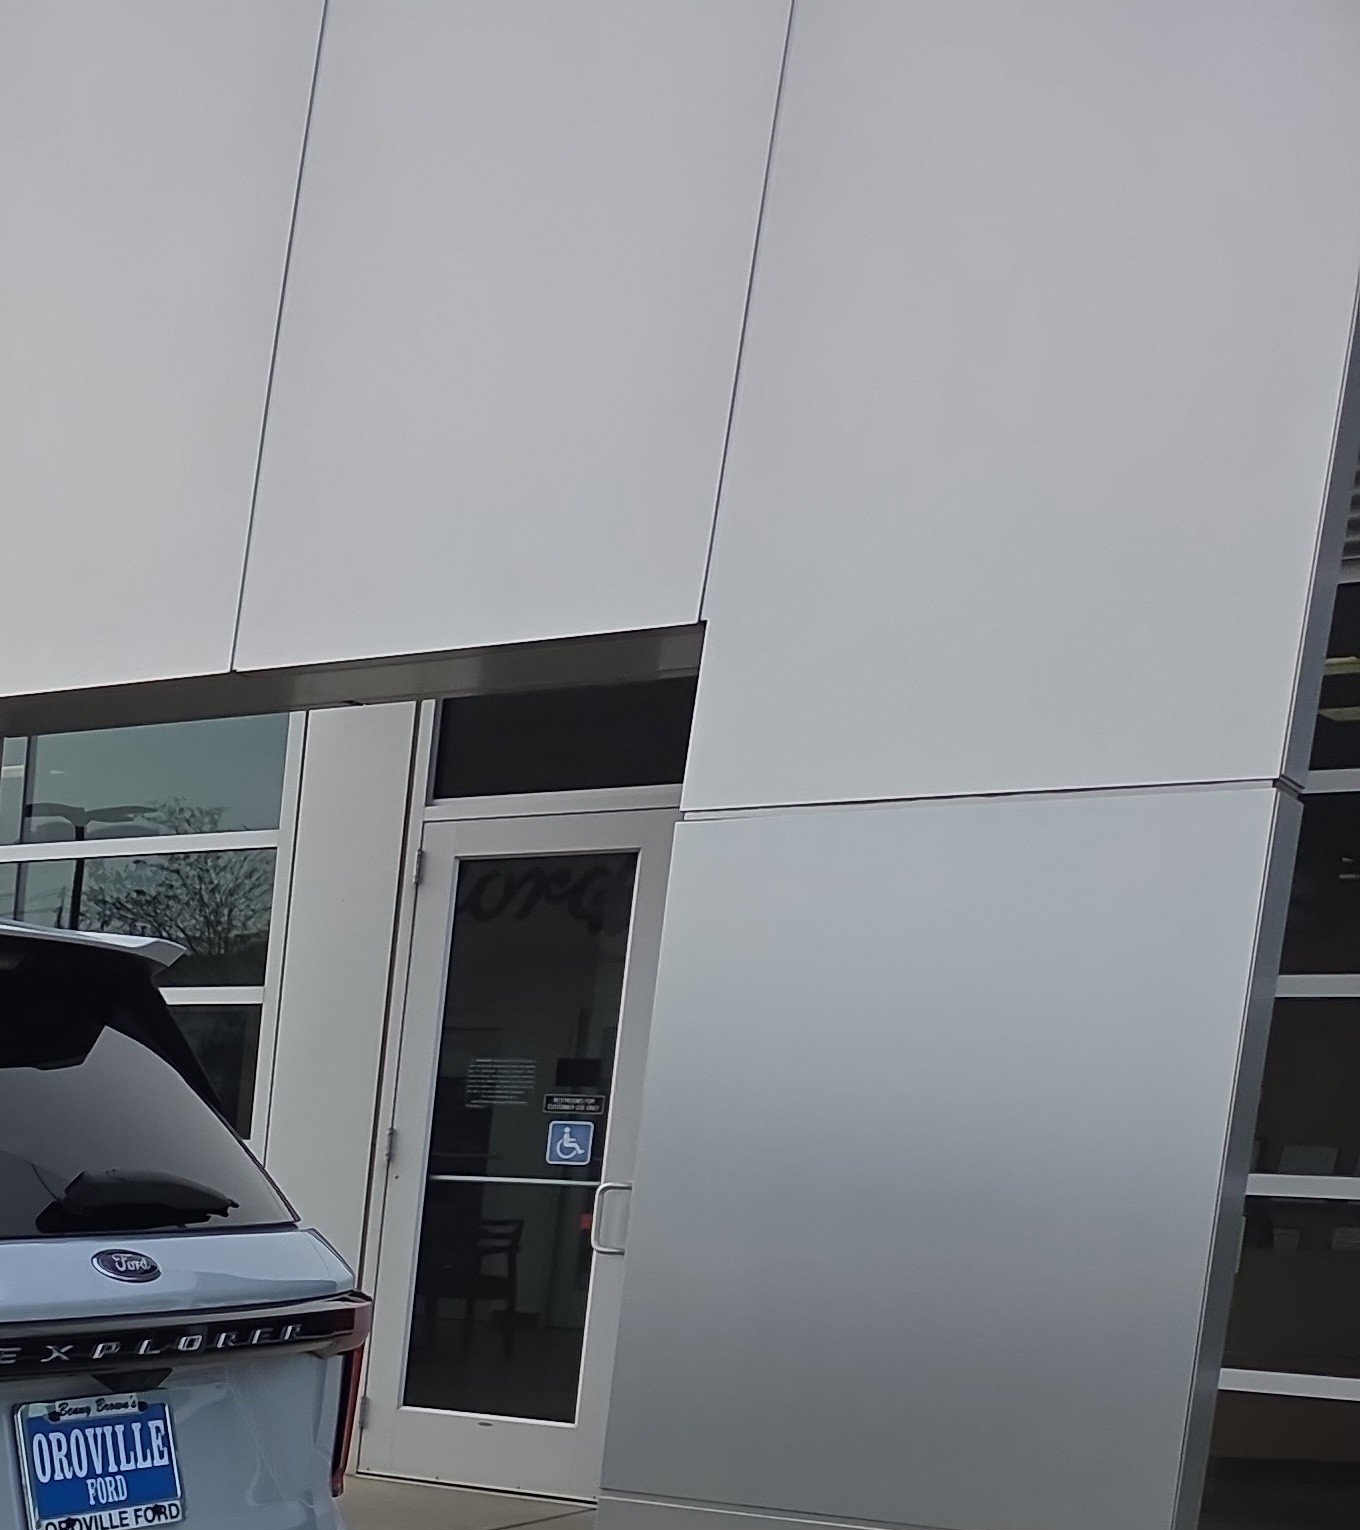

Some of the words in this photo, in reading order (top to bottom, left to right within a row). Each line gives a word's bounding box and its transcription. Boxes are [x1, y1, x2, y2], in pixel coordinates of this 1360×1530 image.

[32, 1419, 170, 1484] OROVILLE
[86, 1474, 129, 1506] FORD
[133, 1502, 180, 1526] FORD
